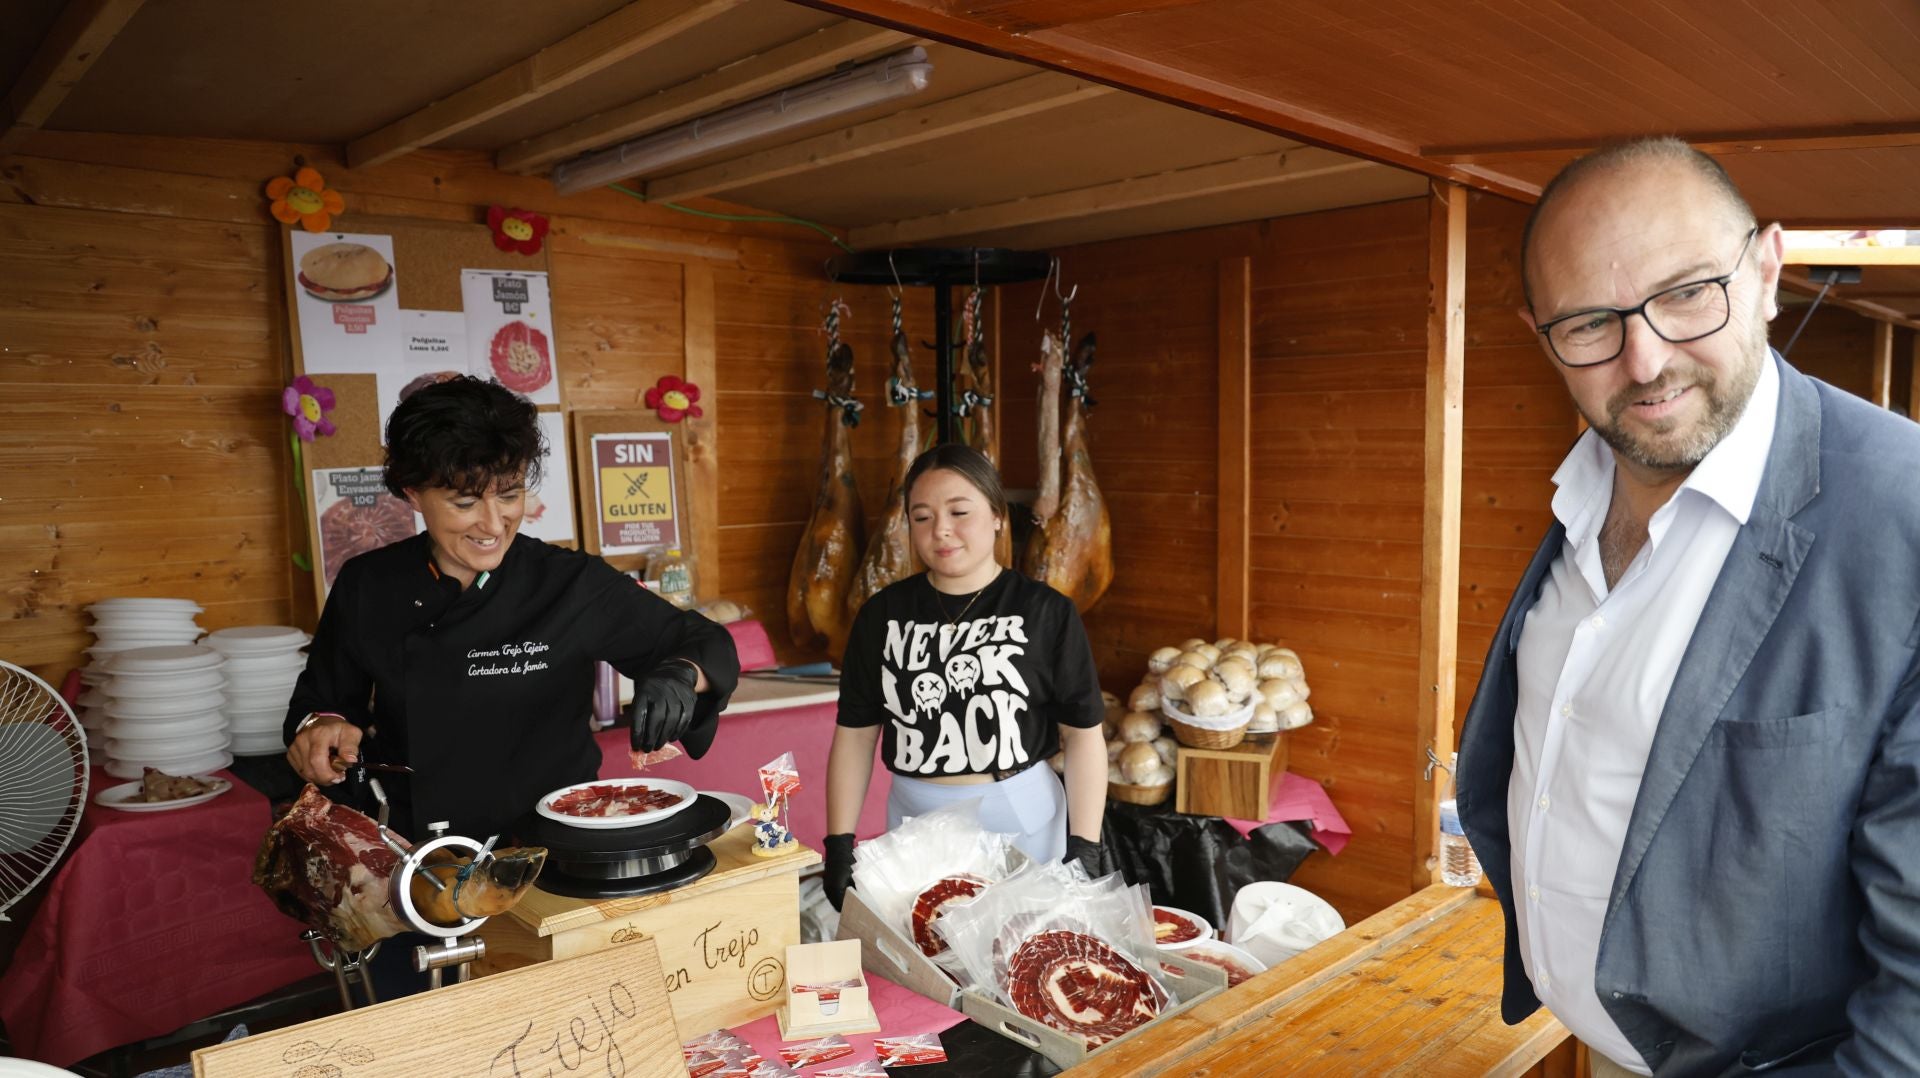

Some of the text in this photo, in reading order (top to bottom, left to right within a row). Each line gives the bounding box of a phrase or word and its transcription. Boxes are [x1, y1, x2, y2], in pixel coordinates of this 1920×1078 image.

[497, 278, 522, 289] Plato
[614, 444, 654, 463] SIN
[332, 473, 358, 483] Plato
[354, 495, 374, 505] 10€
[609, 503, 667, 517] GLUTEN
[620, 534, 660, 543] SIN GLUTEN
[467, 641, 549, 658] Carmen Trejo Tejeiro
[883, 615, 1029, 672] NEVER
[468, 660, 548, 677] Cortadora de Jamón
[892, 689, 1029, 774] BACK
[694, 920, 759, 969] Trejo
